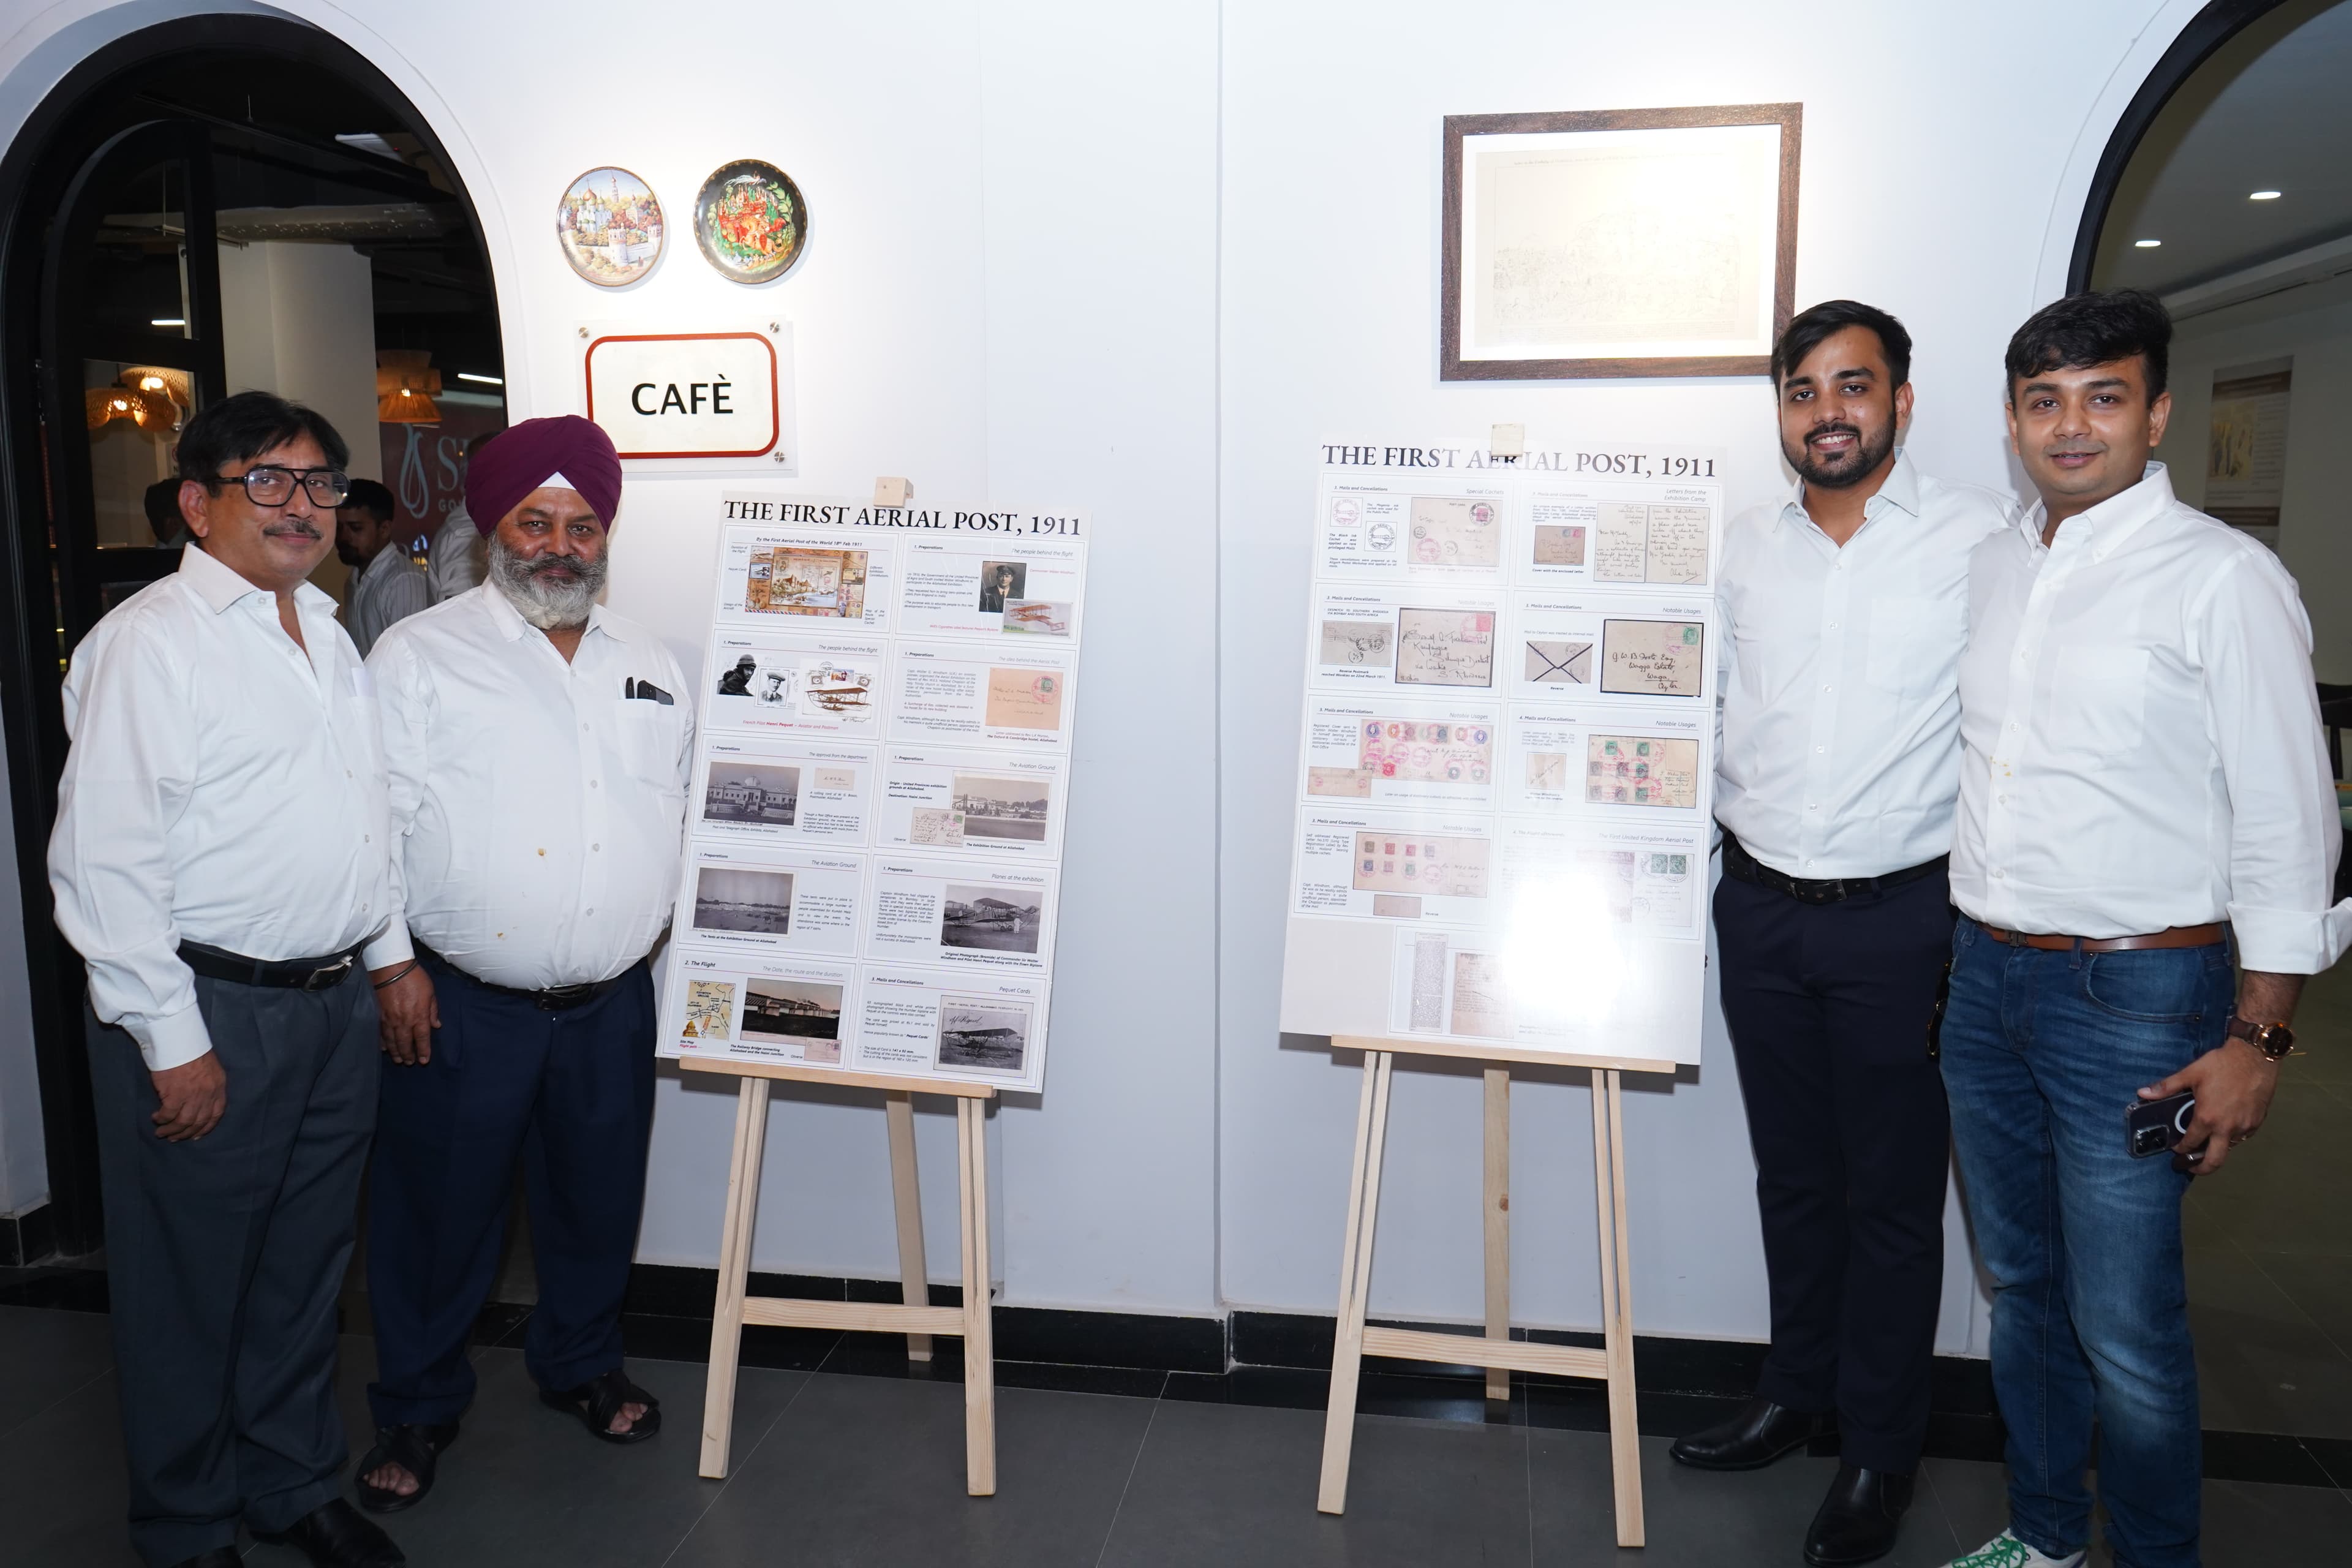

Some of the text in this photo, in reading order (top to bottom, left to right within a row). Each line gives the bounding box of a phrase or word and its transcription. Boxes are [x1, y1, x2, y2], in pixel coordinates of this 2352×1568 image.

[631, 374, 733, 415] CAFÈ
[1322, 444, 1376, 466] THE
[1383, 447, 1461, 468] FIRST
[1575, 452, 1652, 478] POST,
[1661, 457, 1716, 477] 1911
[725, 500, 1080, 536] THE FIRST AERIAL POST, 1911
